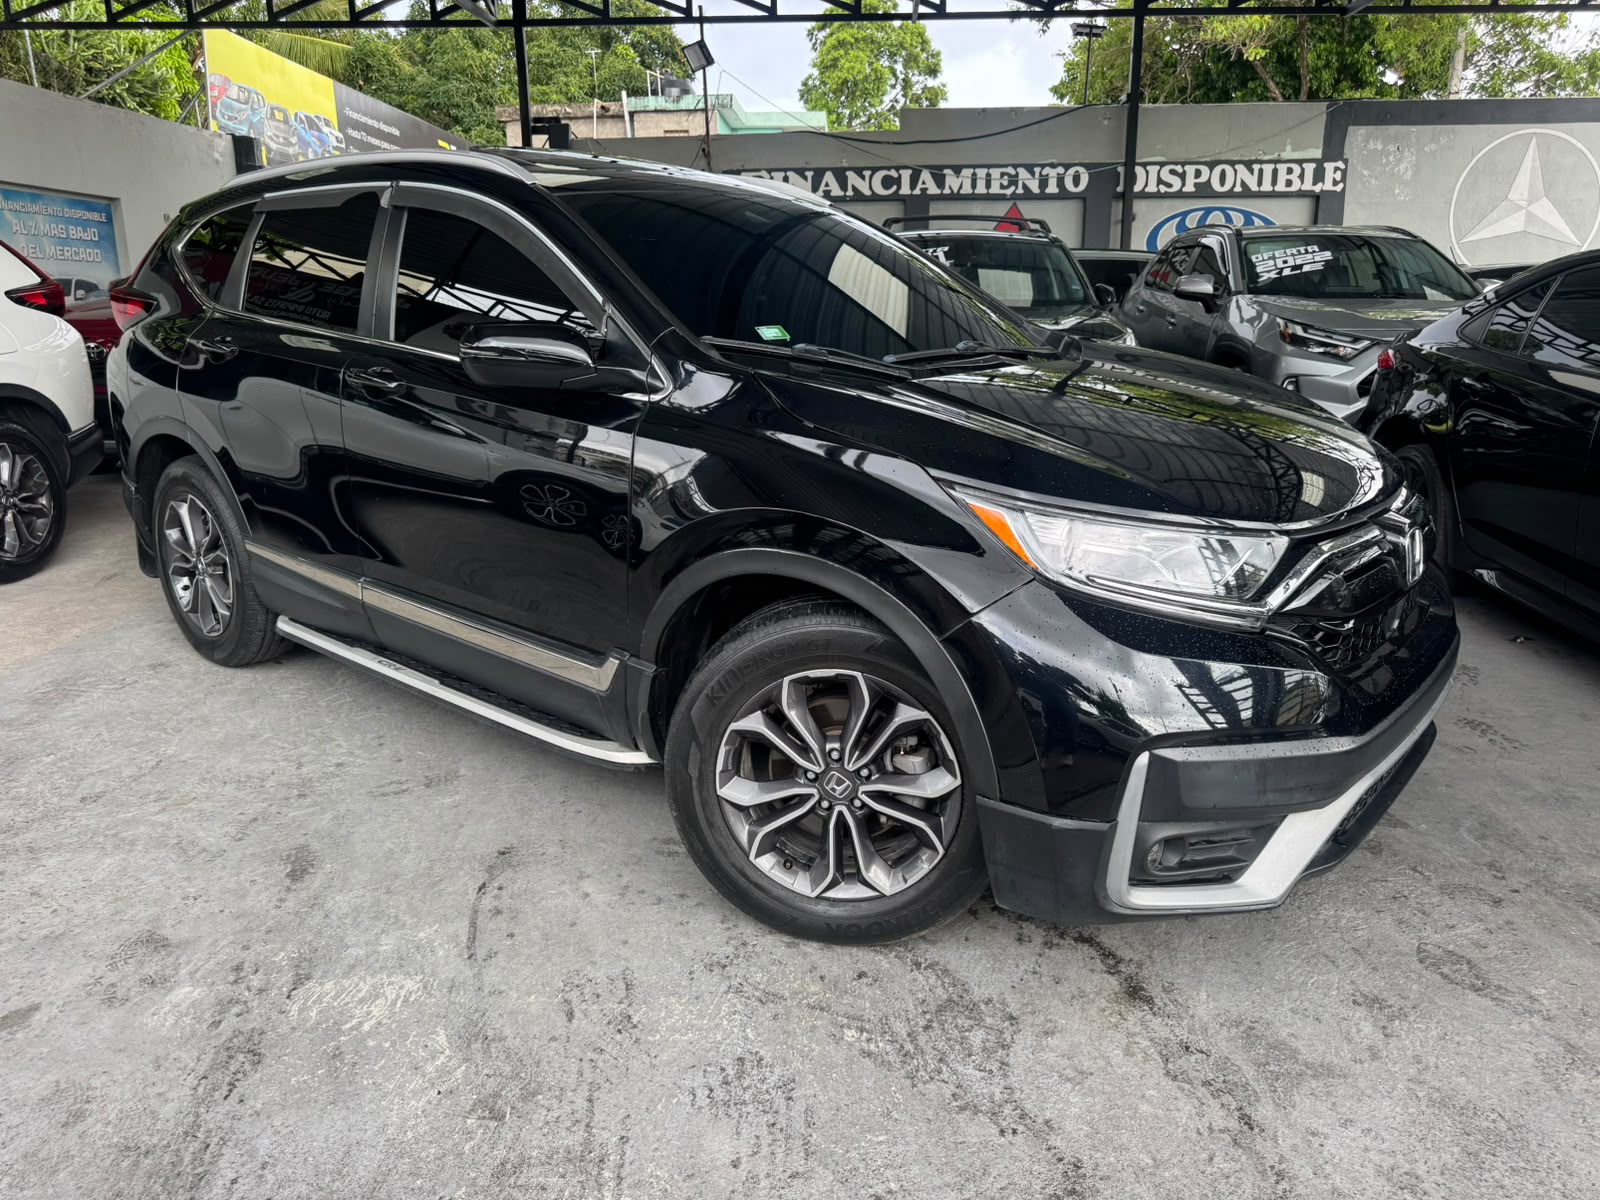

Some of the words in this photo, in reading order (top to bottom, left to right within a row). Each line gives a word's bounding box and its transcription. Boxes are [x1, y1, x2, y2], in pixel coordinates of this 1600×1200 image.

[741, 165, 1089, 197] NANCIAMIENTO
[1117, 161, 1345, 194] DISPONIBLE
[64, 208, 108, 222] DISPONIBLE
[13, 220, 28, 236] AL
[40, 223, 67, 239] MAS
[69, 225, 100, 242] BAJO
[20, 243, 44, 260] DEL
[46, 245, 102, 263] MERCADO
[1251, 244, 1319, 262] OFERTA
[1255, 250, 1333, 273] 2022
[1257, 261, 1326, 282] XLE
